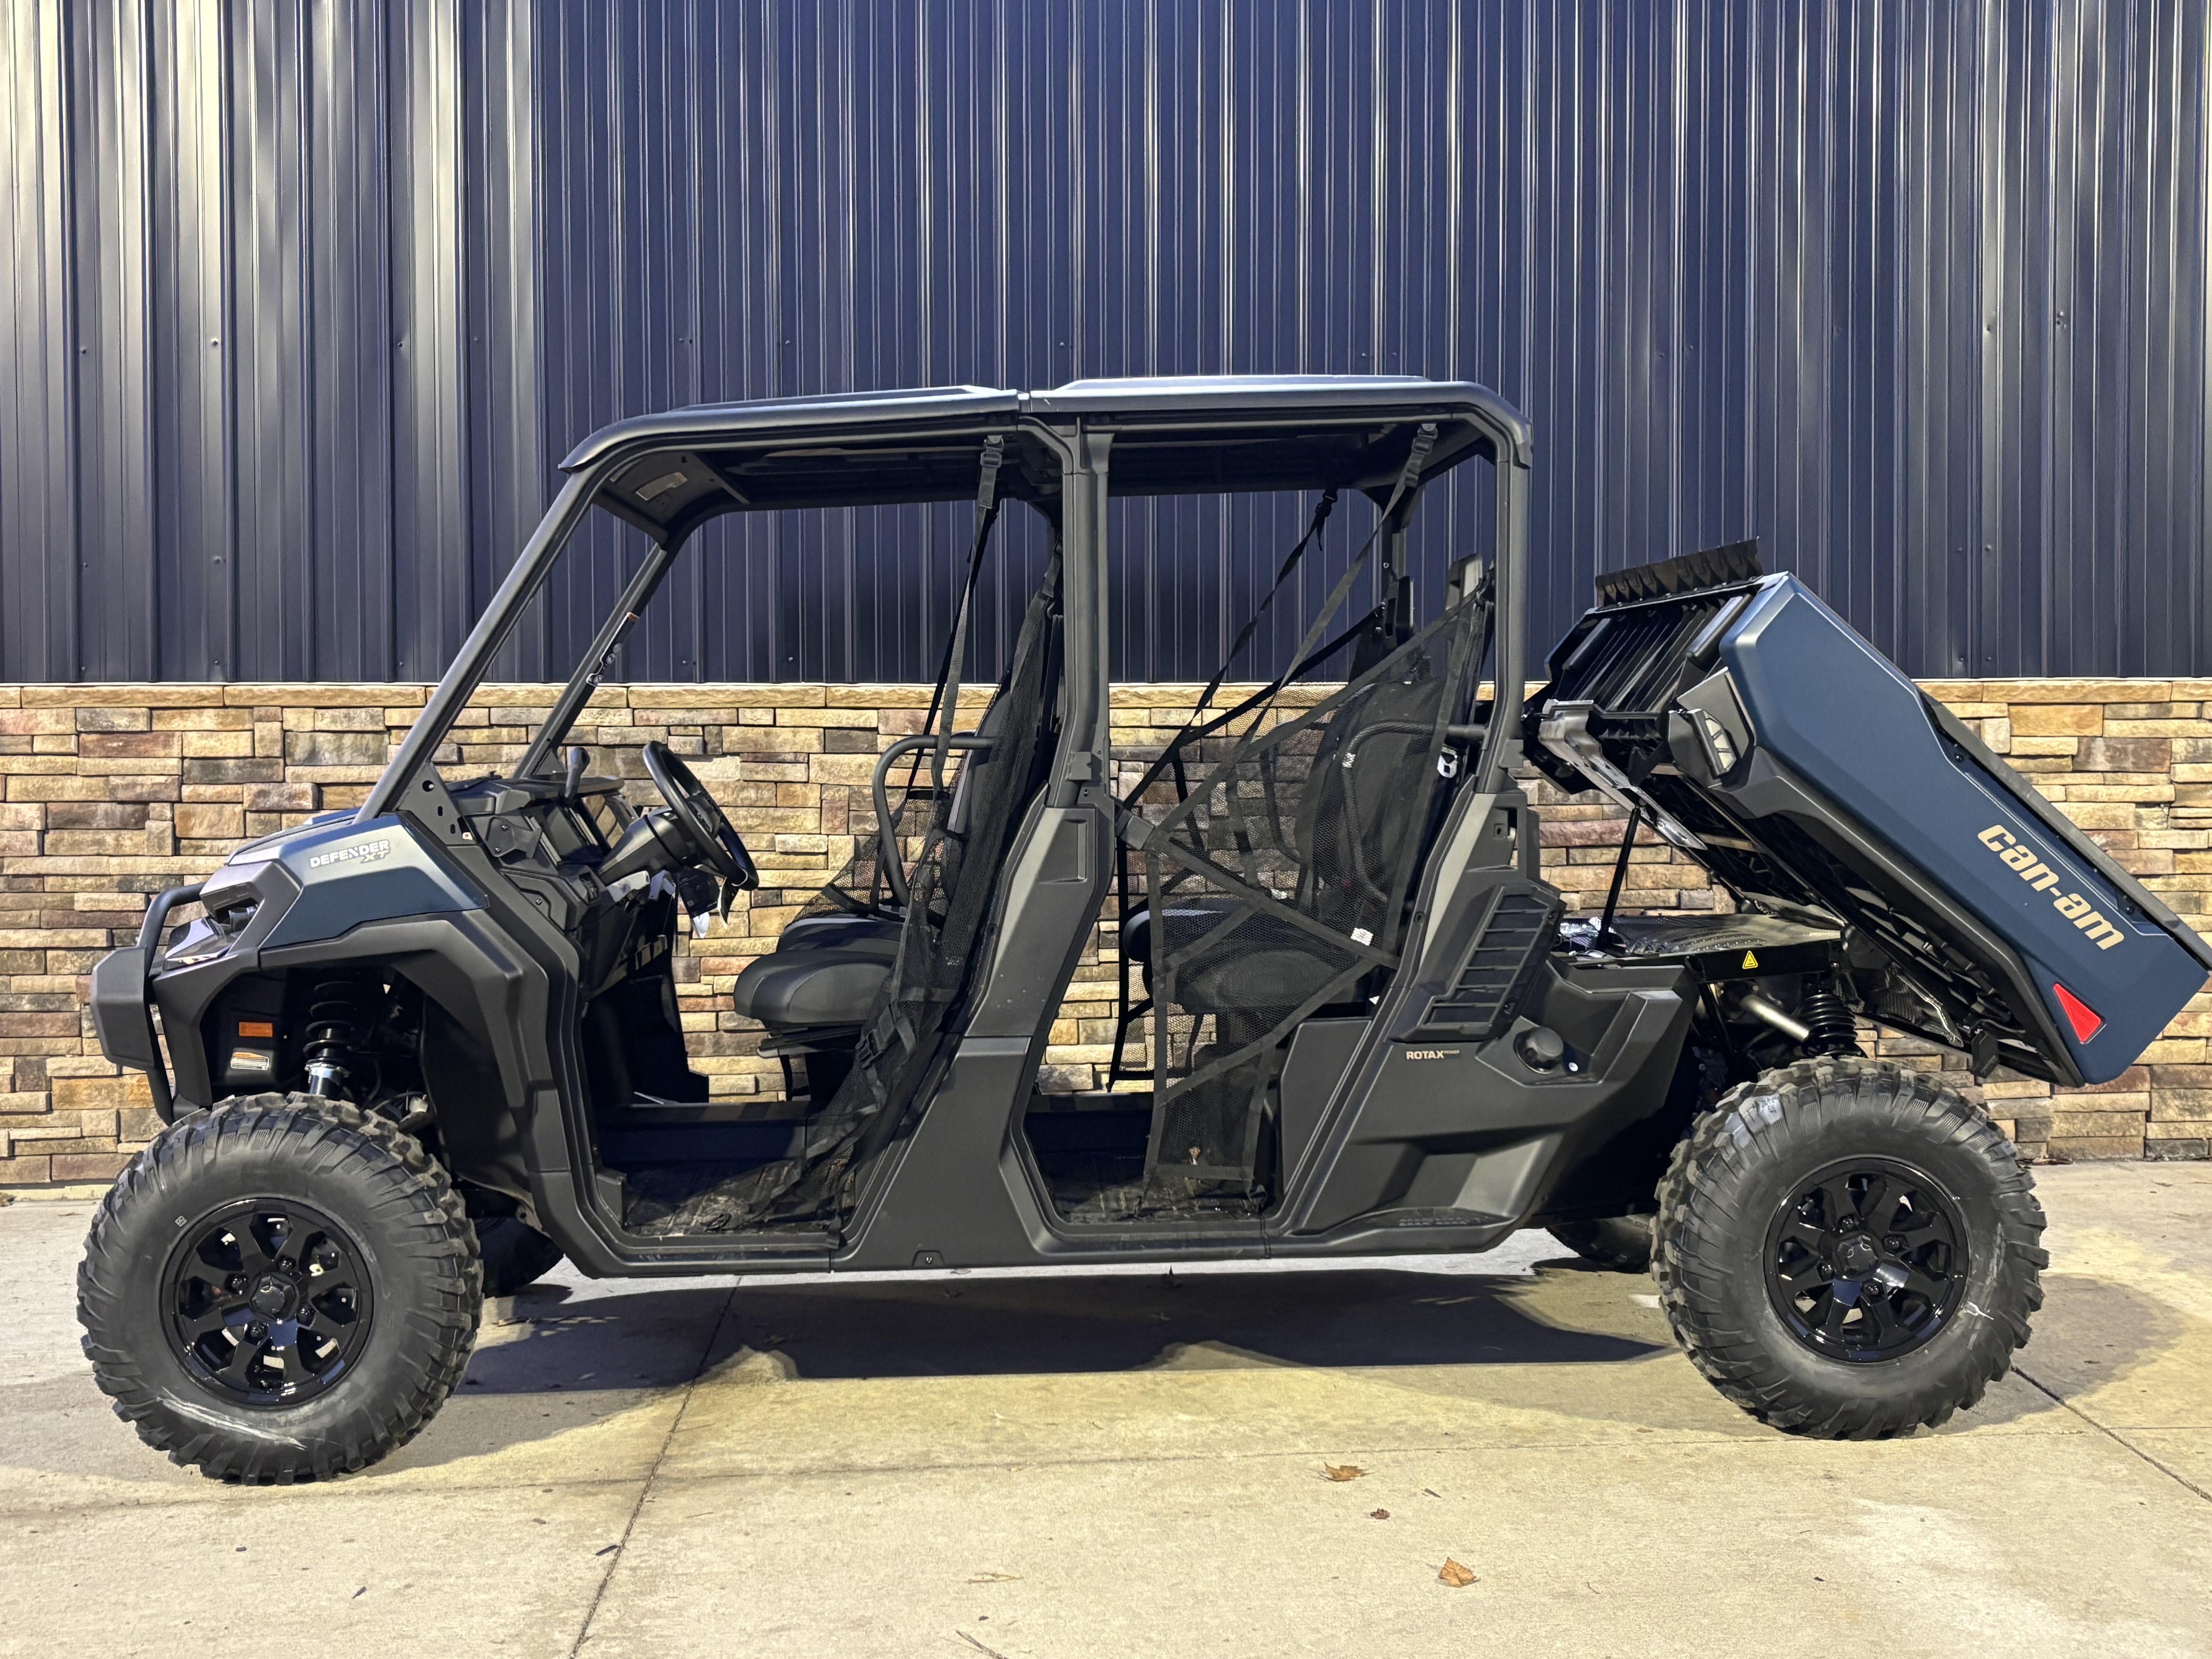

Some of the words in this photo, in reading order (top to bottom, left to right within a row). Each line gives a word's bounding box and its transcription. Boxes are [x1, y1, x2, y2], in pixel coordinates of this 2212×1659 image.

[310, 840, 390, 868] DEFENDER
[362, 849, 390, 862] XT
[1977, 824, 2124, 950] can-am
[1406, 1050, 1444, 1060] ROTAX
